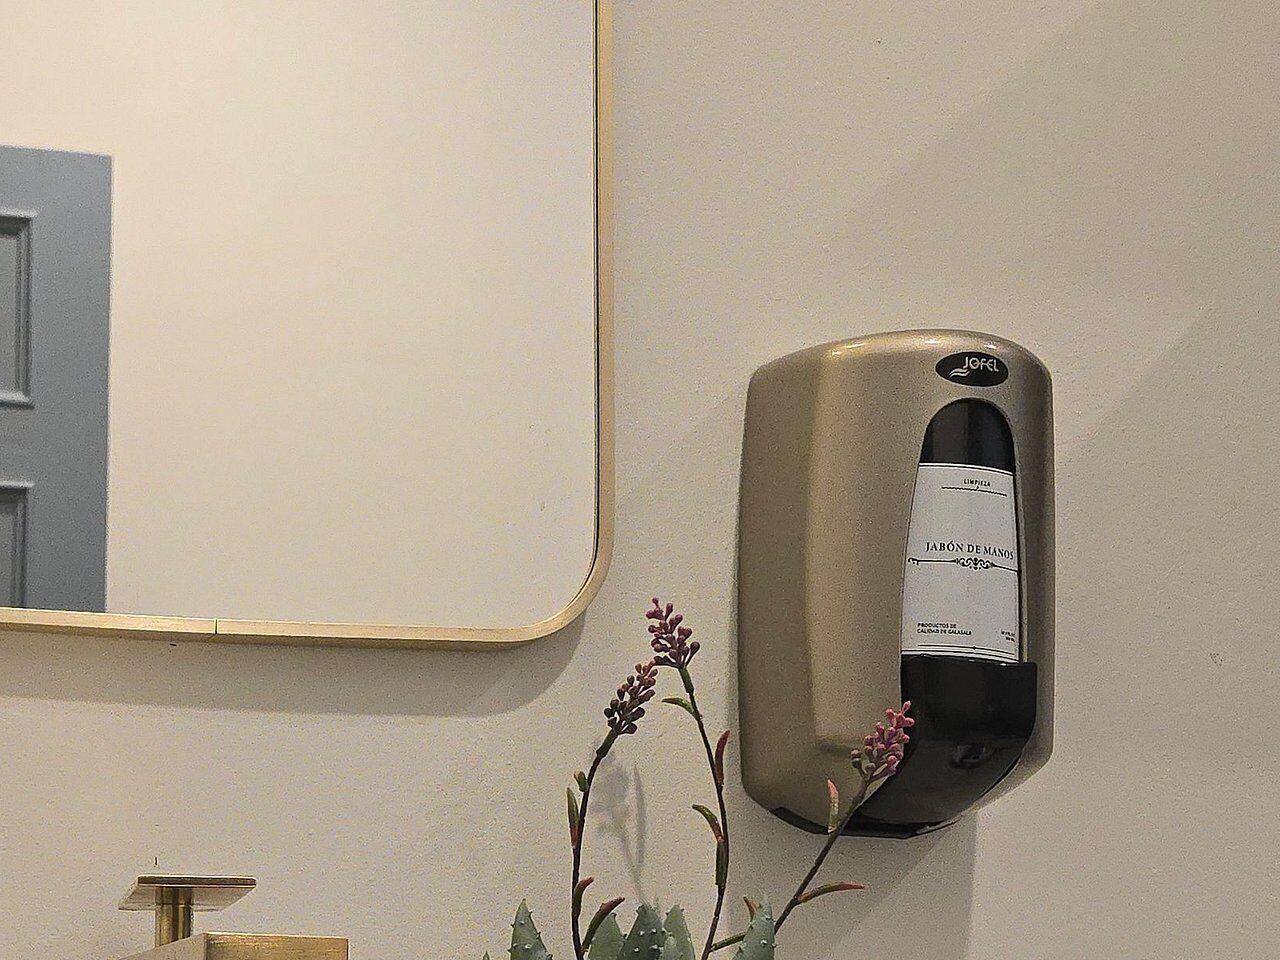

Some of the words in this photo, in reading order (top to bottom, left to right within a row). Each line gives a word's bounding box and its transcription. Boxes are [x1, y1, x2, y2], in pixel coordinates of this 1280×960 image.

[963, 356, 1000, 372] JOFEL
[963, 479, 991, 487] LIMPIEZA
[925, 540, 963, 552] JABÓN
[966, 543, 981, 554] DE
[983, 546, 1014, 560] MANOS
